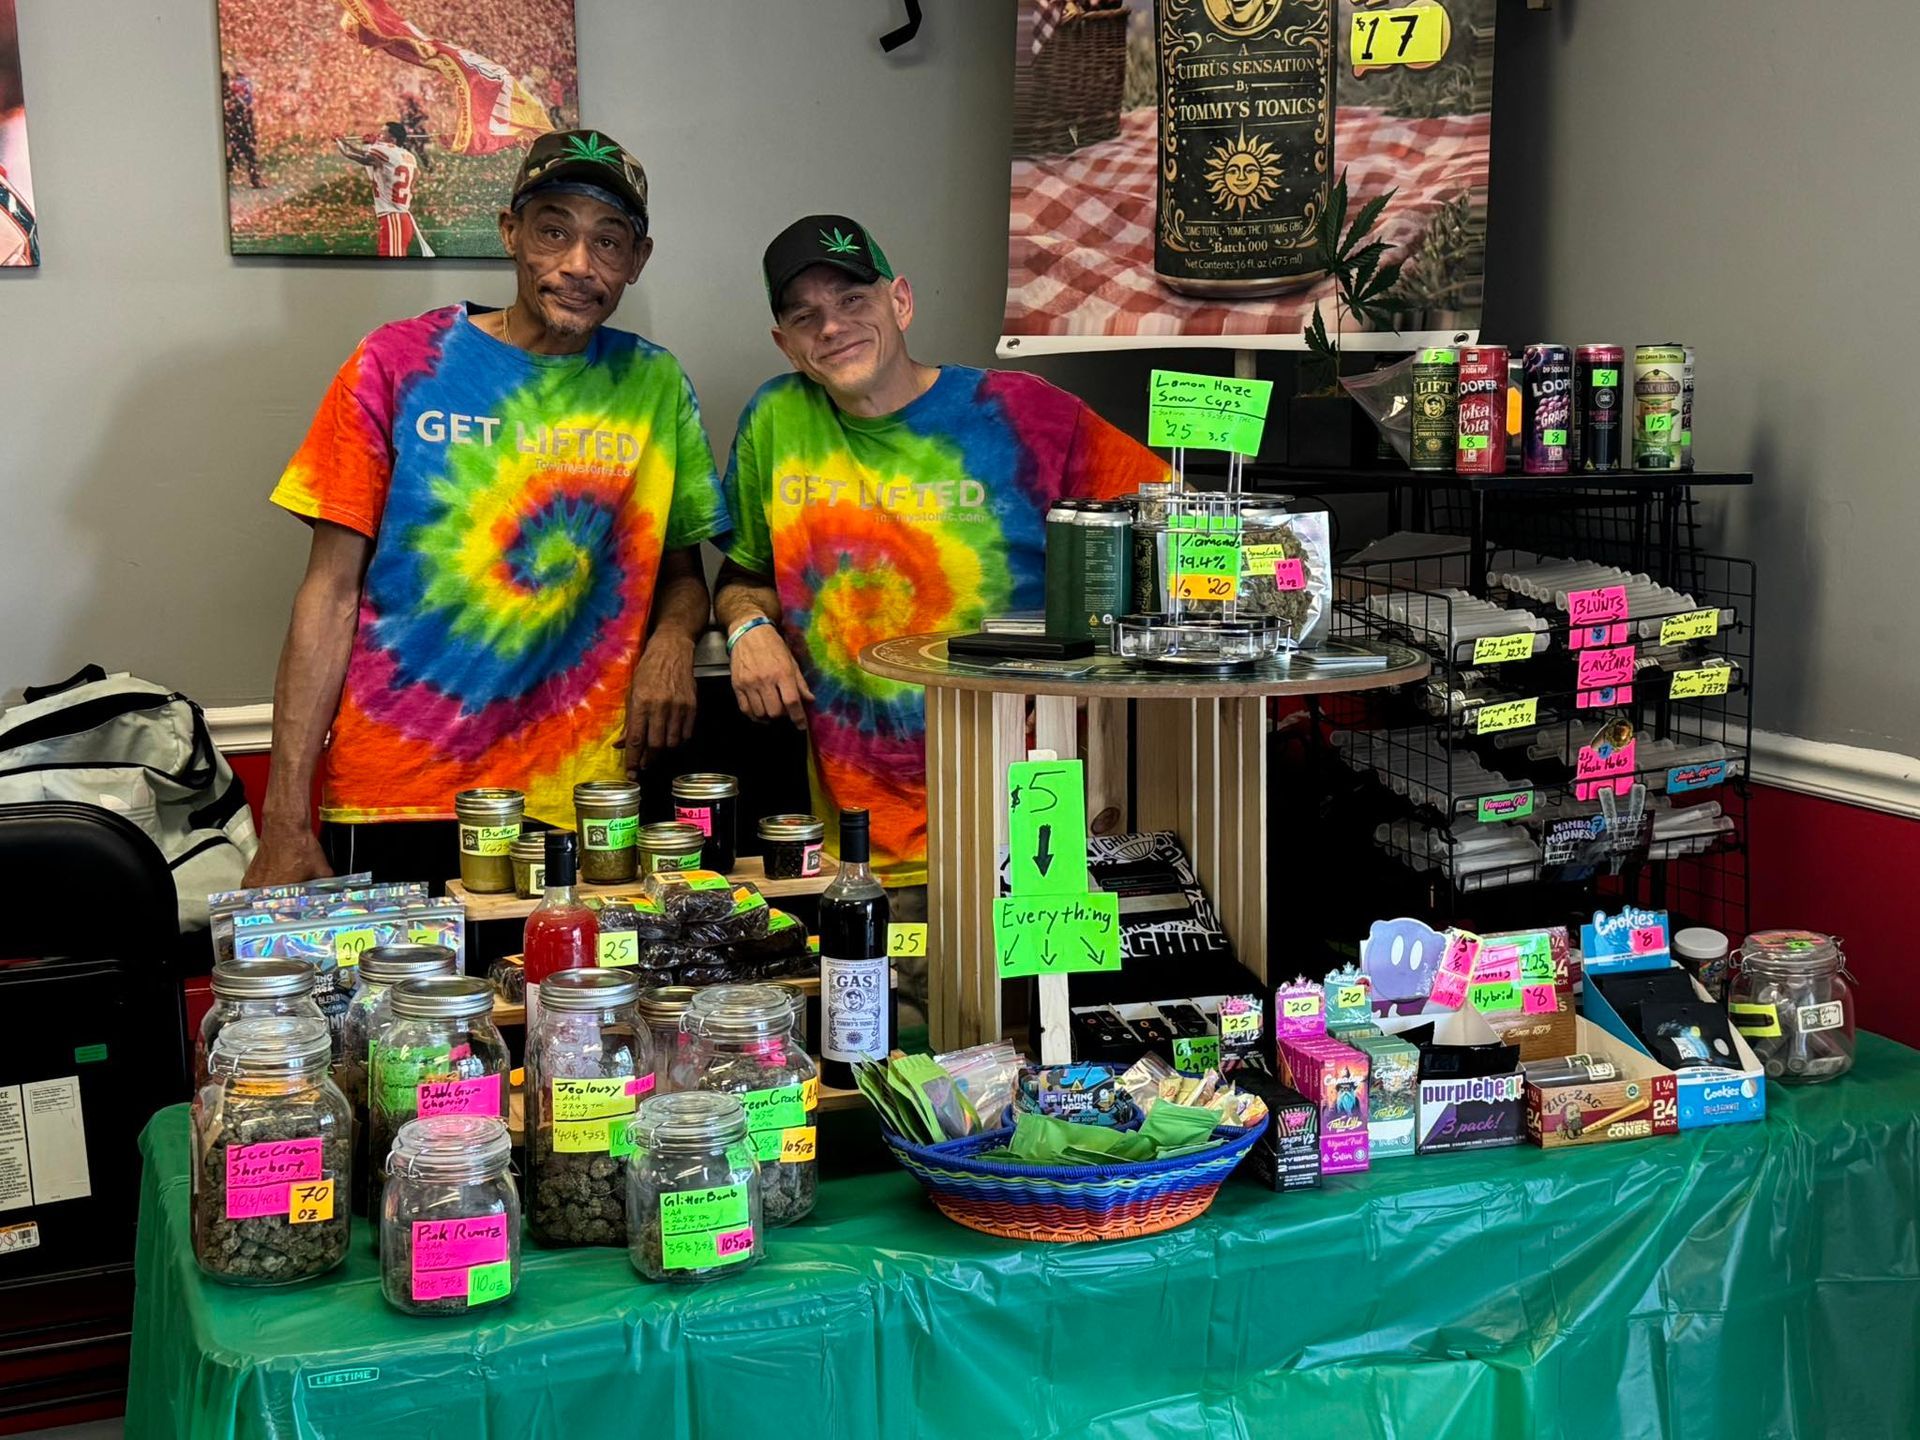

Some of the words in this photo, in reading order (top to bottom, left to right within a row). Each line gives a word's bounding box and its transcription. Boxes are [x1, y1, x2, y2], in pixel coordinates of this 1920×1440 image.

[1239, 43, 1249, 56] A
[1177, 60, 1229, 79] CITRUS
[1232, 57, 1315, 75] SENSATION
[1236, 80, 1249, 93] By
[1179, 101, 1250, 121] TOMMY'S
[1255, 97, 1315, 117] TONICS
[1214, 242, 1246, 253] Batch
[1185, 258, 1198, 269] Net
[1432, 352, 1444, 361] 5
[1601, 371, 1611, 385] 8
[1214, 381, 1252, 398] Haze
[1419, 381, 1452, 394] LIFT
[1458, 380, 1497, 396] OOPER
[1159, 390, 1197, 403] Snow
[1650, 416, 1665, 429] 15
[416, 410, 500, 447] GET
[516, 421, 640, 464] LIFTED
[1208, 431, 1230, 442] 3.5
[1466, 437, 1475, 448] 8
[1552, 432, 1560, 443] 8
[779, 474, 847, 507] GET
[859, 479, 985, 511] LIFTED
[1574, 596, 1624, 615] BLUNTS
[1478, 639, 1497, 652] King
[1581, 656, 1631, 673] CAVIARS
[1508, 703, 1525, 711] Ape
[1579, 763, 1601, 774] Hash
[1011, 770, 1066, 813] $5
[1484, 799, 1513, 809] Venom
[481, 828, 516, 838] Butter
[1553, 820, 1591, 832] MAMBA
[1546, 830, 1598, 845] MADNESS
[1002, 902, 1112, 934] Everything
[1595, 908, 1654, 935] Cookies
[604, 939, 631, 960] 25
[893, 933, 921, 952] 25
[836, 975, 872, 988] GAS
[1475, 988, 1513, 1007] Hybrid
[1176, 1040, 1218, 1056] Ghost
[555, 1082, 621, 1097] Jealousy
[770, 1089, 804, 1105] Crack
[1423, 1076, 1523, 1105] purplebear
[1704, 1085, 1740, 1101] Cookies
[1061, 1093, 1093, 1102] FLYING
[1544, 1089, 1603, 1113] ZIG-ZAG
[1653, 1097, 1677, 1120] 24
[1441, 1118, 1457, 1135] 3
[1455, 1112, 1505, 1138] pack!
[1607, 1123, 1651, 1138] CONES
[1655, 1119, 1677, 1127] PACK
[1278, 1154, 1319, 1163] HYBRID
[231, 1160, 304, 1177] Sherbert
[296, 1186, 329, 1203] 70
[418, 1223, 448, 1242] Pink
[454, 1223, 502, 1240] Runtz
[317, 1370, 371, 1384] LIFETIME
